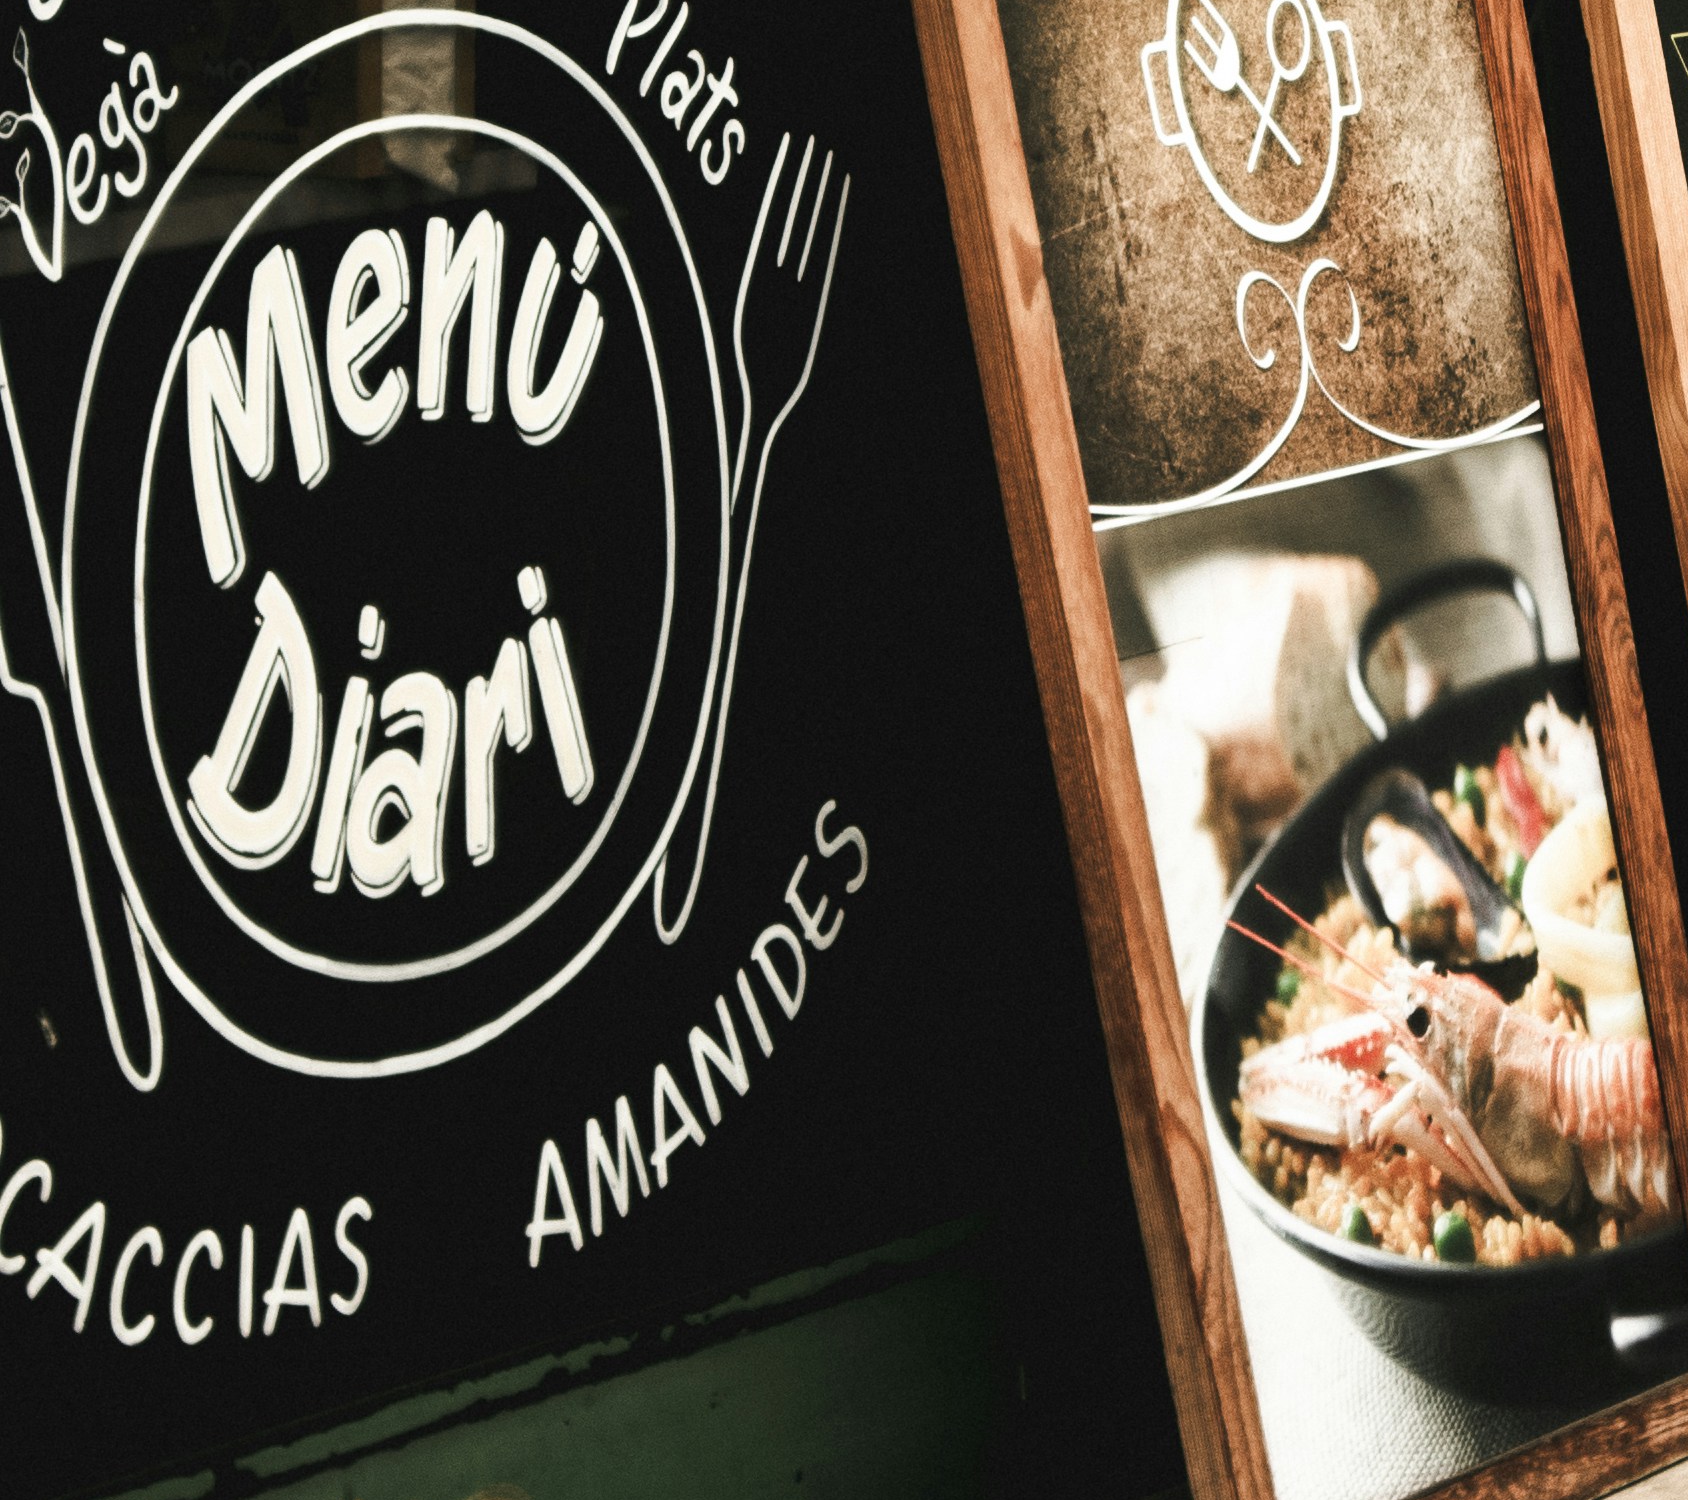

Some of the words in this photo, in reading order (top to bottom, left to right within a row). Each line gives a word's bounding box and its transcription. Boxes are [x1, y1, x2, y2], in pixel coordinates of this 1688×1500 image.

[188, 209, 602, 587] Menú
[188, 566, 594, 897] Diari
[525, 800, 869, 1267] AMANIDES
[0, 1115, 372, 1345] CACCIAS
